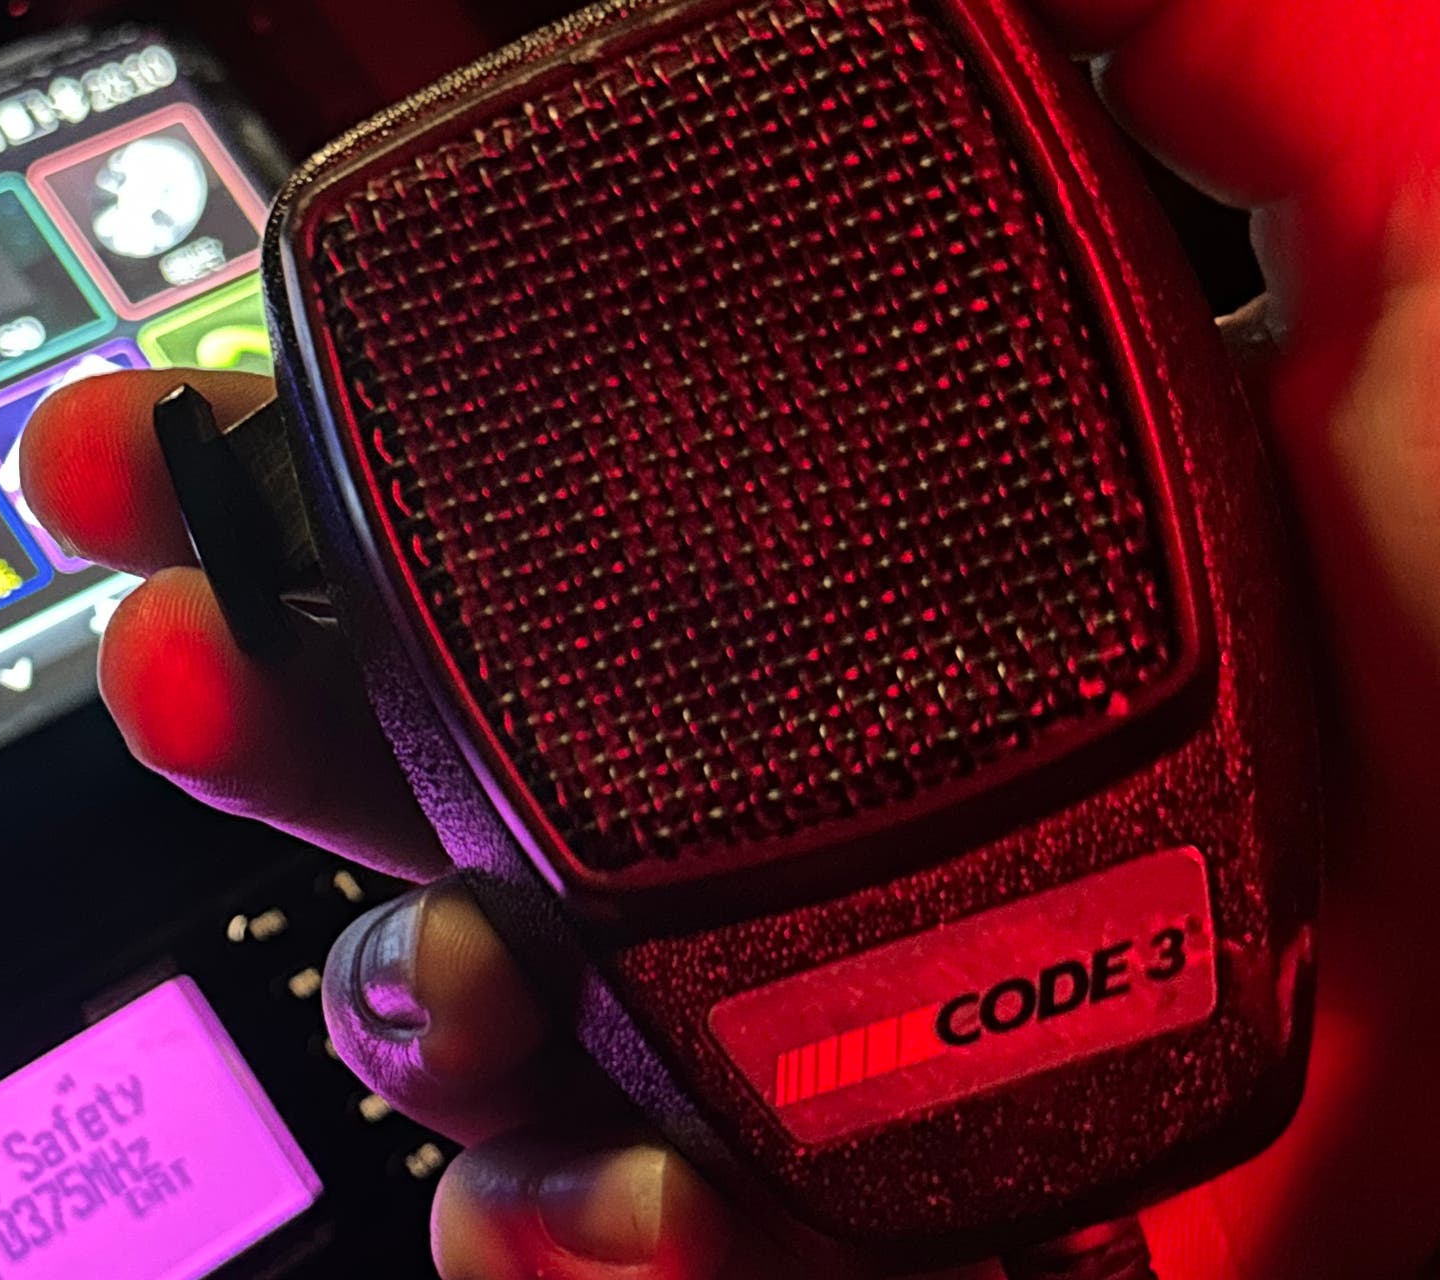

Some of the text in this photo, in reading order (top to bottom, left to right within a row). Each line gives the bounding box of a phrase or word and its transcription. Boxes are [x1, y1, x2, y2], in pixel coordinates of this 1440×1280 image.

[934, 927, 1187, 1047] CODE 3
[3, 1074, 148, 1184] Safety
